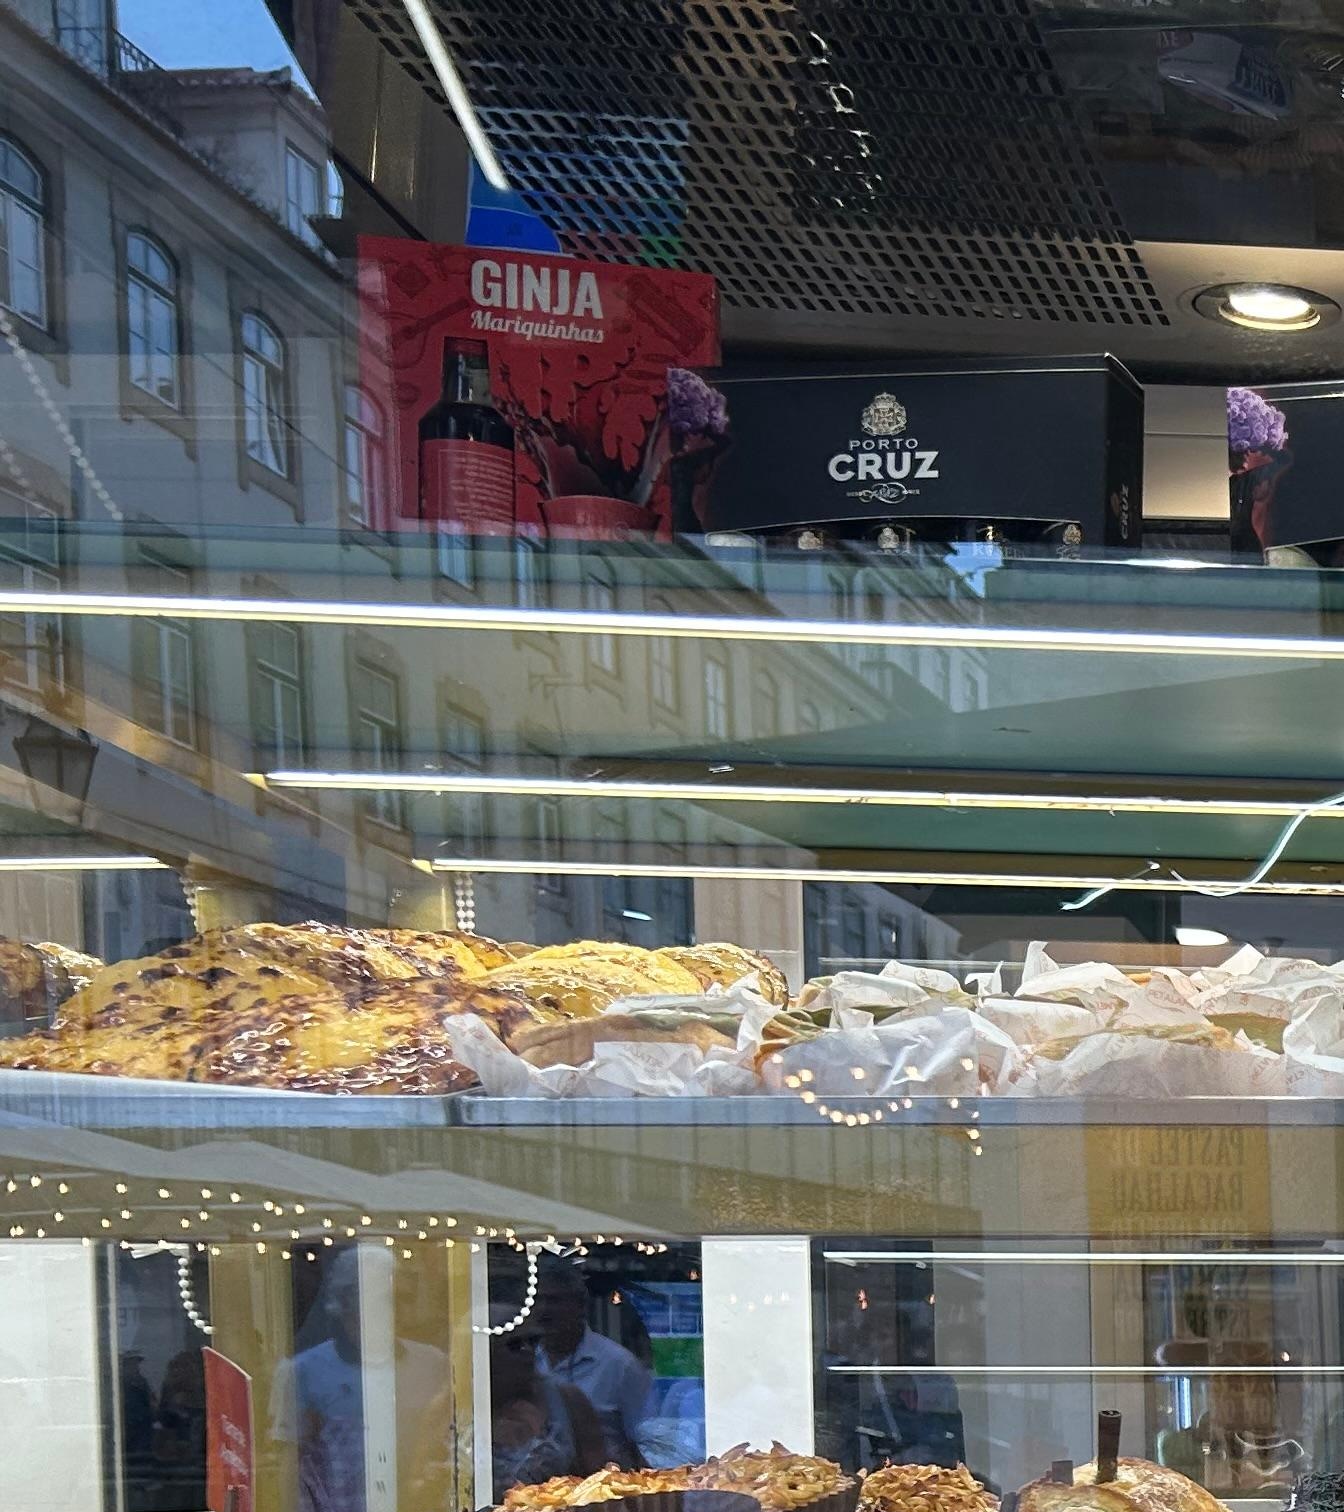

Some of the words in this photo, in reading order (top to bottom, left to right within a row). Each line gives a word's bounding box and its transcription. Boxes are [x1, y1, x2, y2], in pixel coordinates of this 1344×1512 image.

[471, 259, 604, 319] GINJA
[471, 310, 605, 344] Mariquinhas
[849, 438, 919, 451] PORTO
[828, 451, 939, 481] CRUZ
